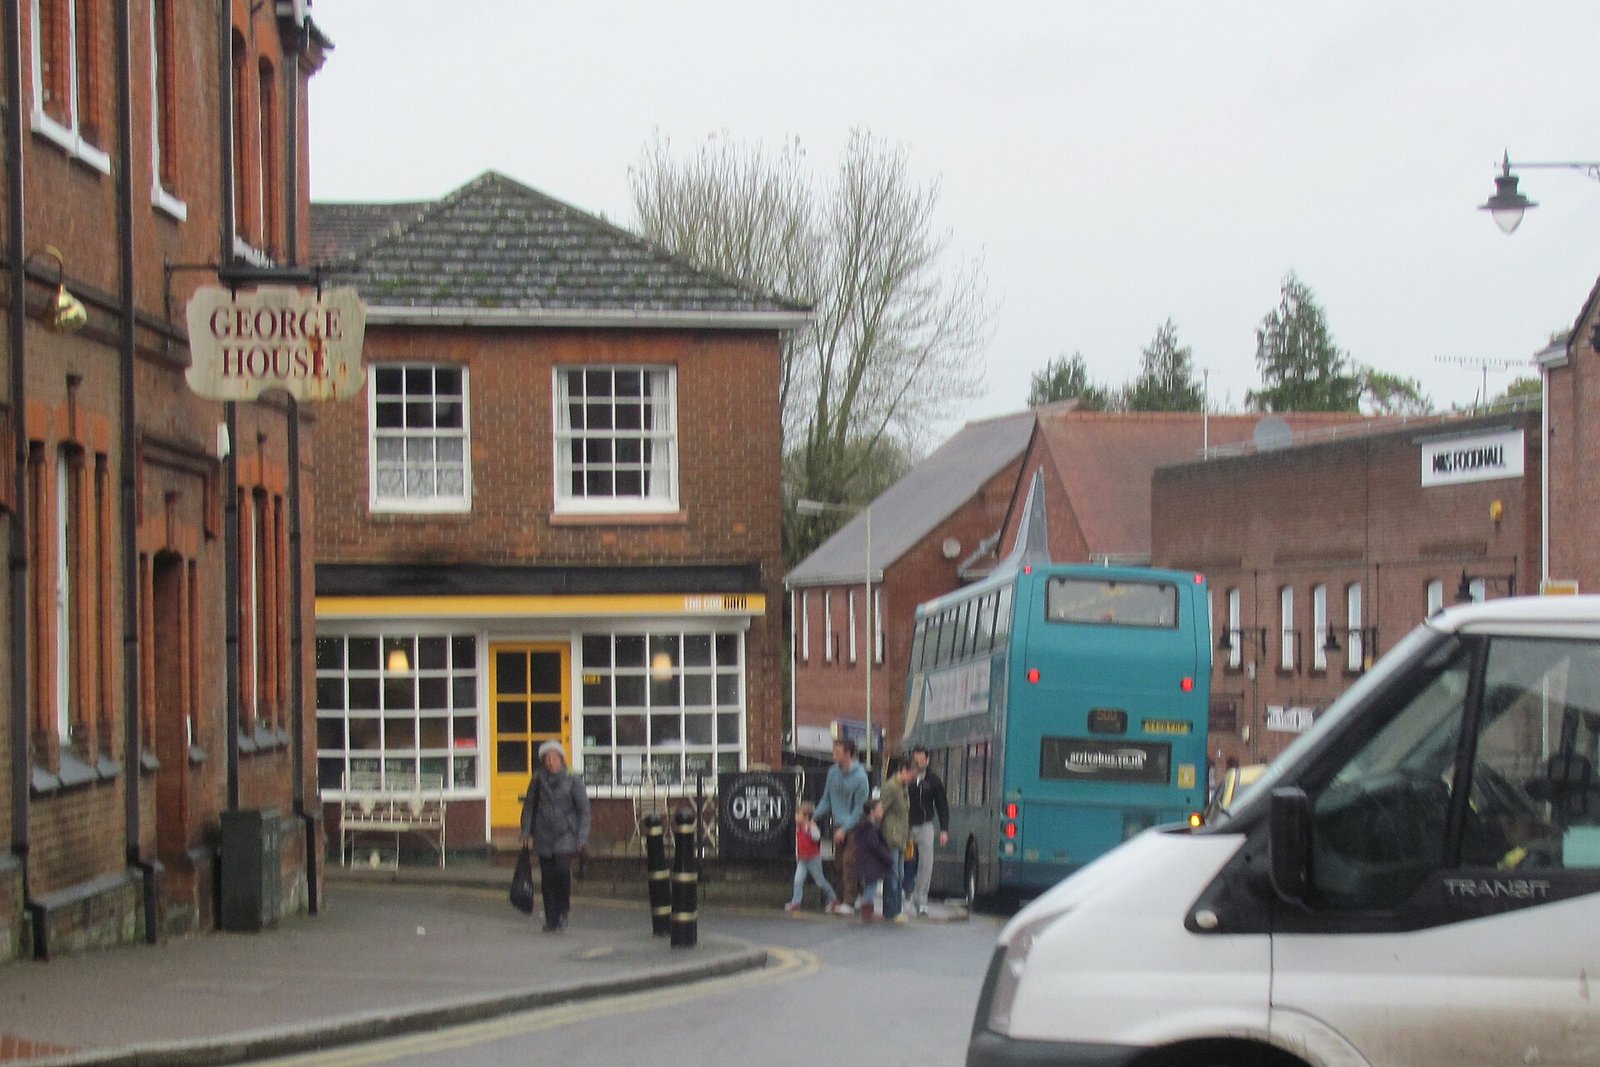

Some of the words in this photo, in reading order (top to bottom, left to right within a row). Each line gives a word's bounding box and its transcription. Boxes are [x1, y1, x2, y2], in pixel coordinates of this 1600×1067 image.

[209, 306, 343, 339] GEORGE
[222, 346, 330, 379] HOUSE
[1453, 445, 1506, 471] FOODHALL
[1069, 751, 1144, 769] arrivabus.co.uk
[733, 796, 781, 819] OPEN
[1442, 879, 1551, 898] TRANSIT
